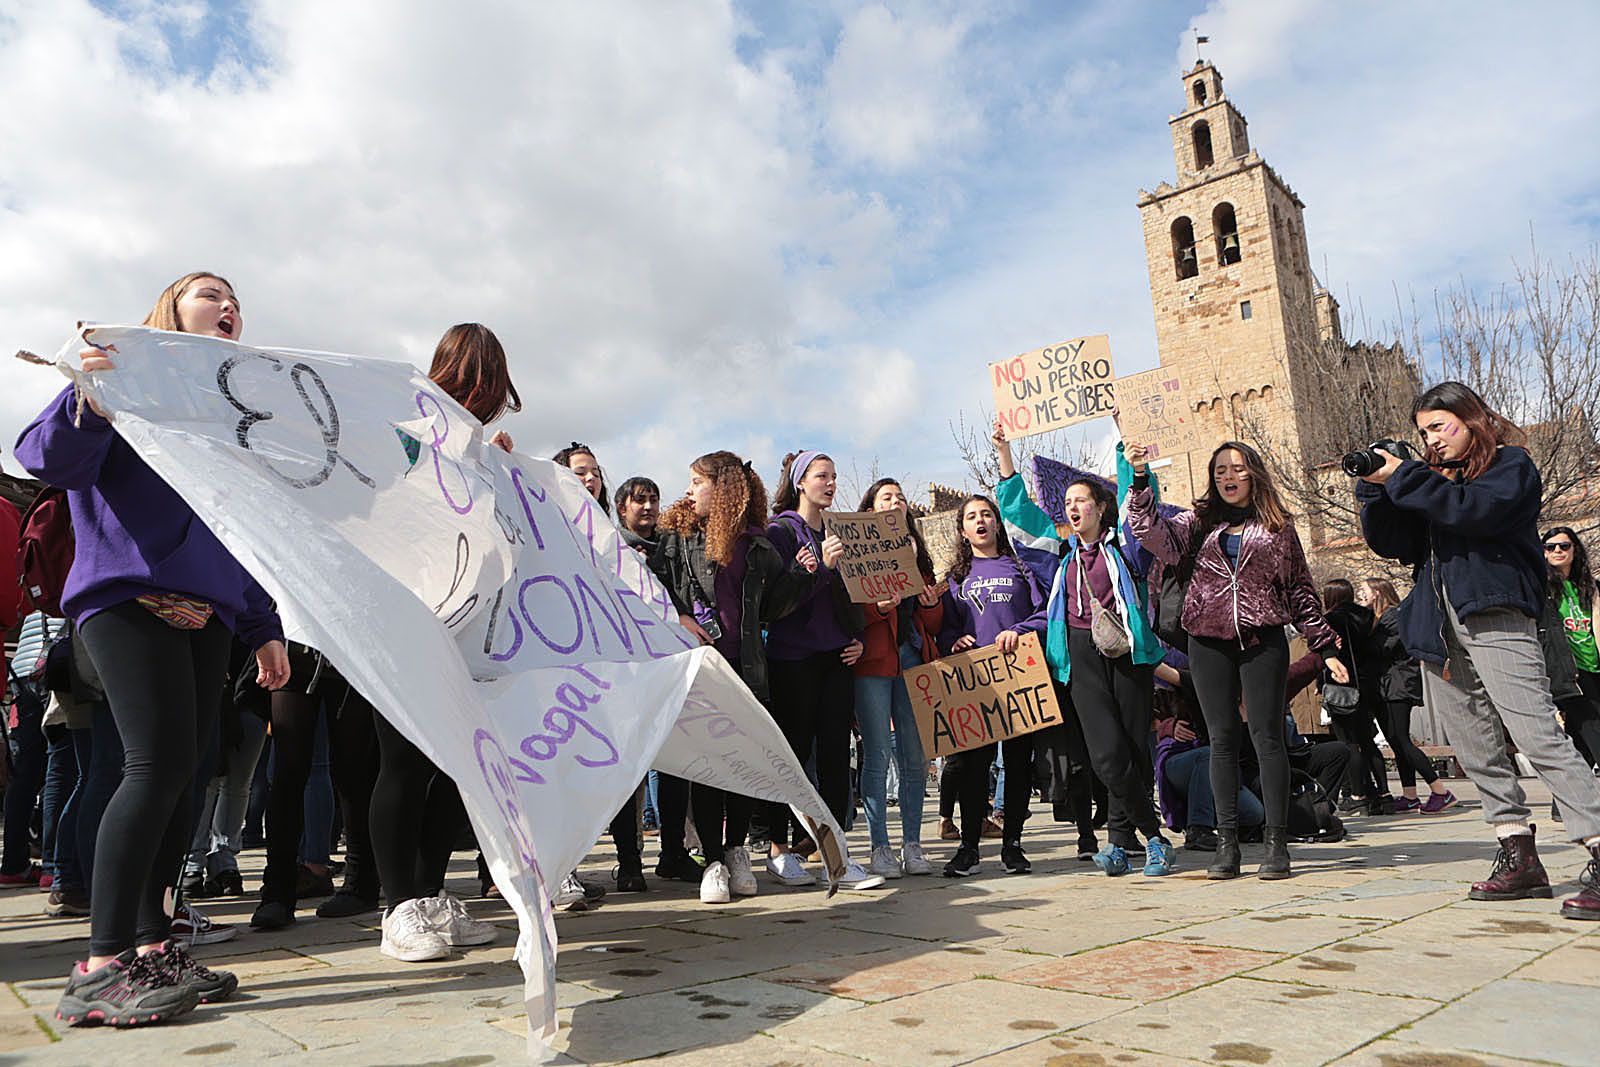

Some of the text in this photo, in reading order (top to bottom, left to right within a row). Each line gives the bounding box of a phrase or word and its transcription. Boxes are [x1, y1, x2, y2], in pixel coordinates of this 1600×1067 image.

[995, 340, 1085, 387] NO SOY
[1013, 359, 1110, 400] UN PERRO
[1162, 379, 1180, 392] TU
[999, 405, 1032, 433] NO
[1035, 396, 1061, 425] ME
[862, 523, 881, 540] LAS
[860, 571, 914, 599] QUEMAR
[942, 651, 1026, 696] MUJER
[933, 683, 1056, 754] Á(R)MATE
